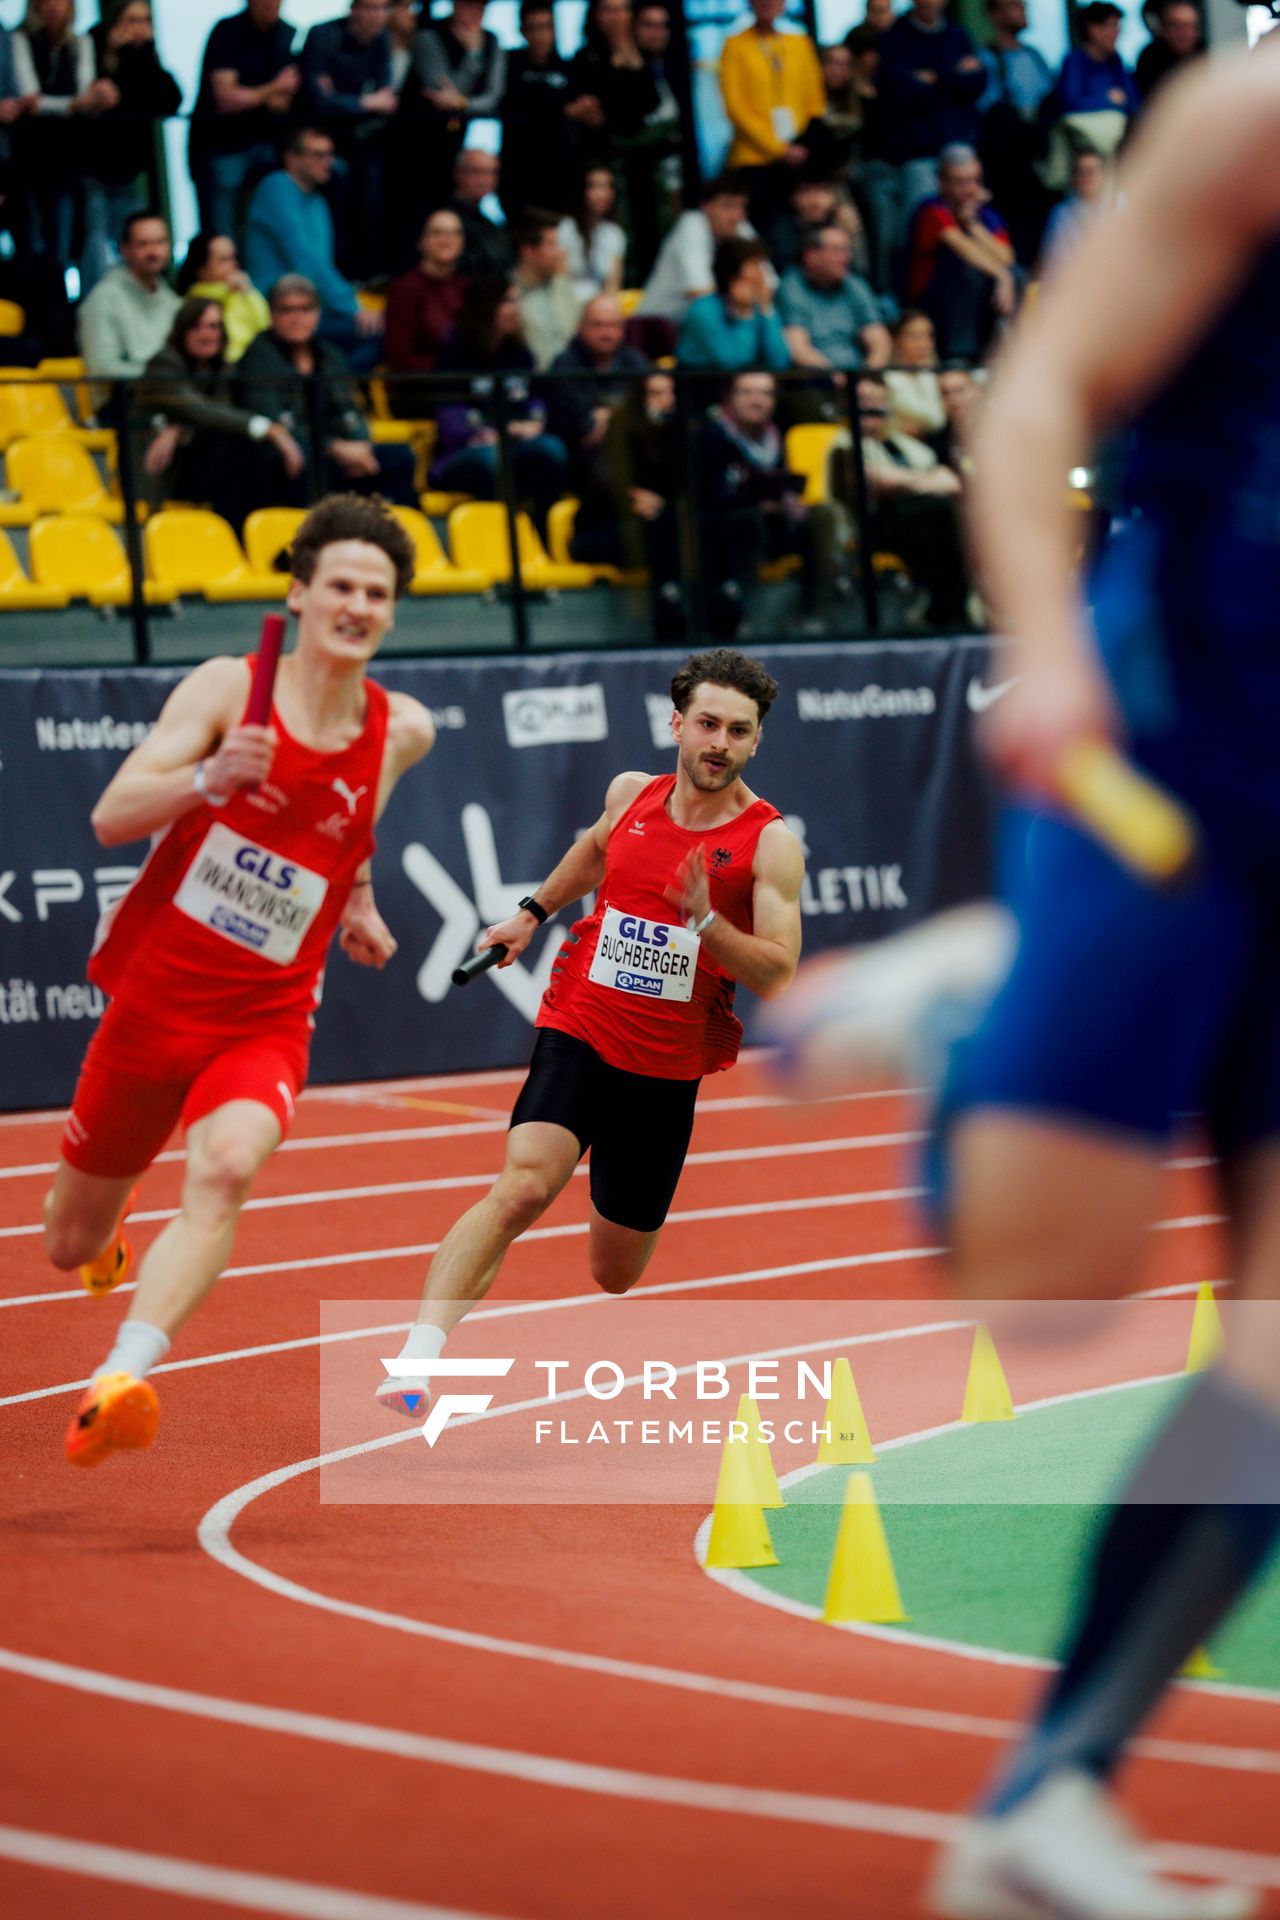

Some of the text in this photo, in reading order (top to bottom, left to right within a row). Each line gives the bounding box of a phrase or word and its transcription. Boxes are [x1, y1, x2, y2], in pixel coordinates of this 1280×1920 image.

[36, 715, 156, 751] NatuGen
[196, 857, 312, 933] IWANOWSKI
[601, 935, 690, 977] BUCHBERGER
[633, 977, 661, 991] PLAN
